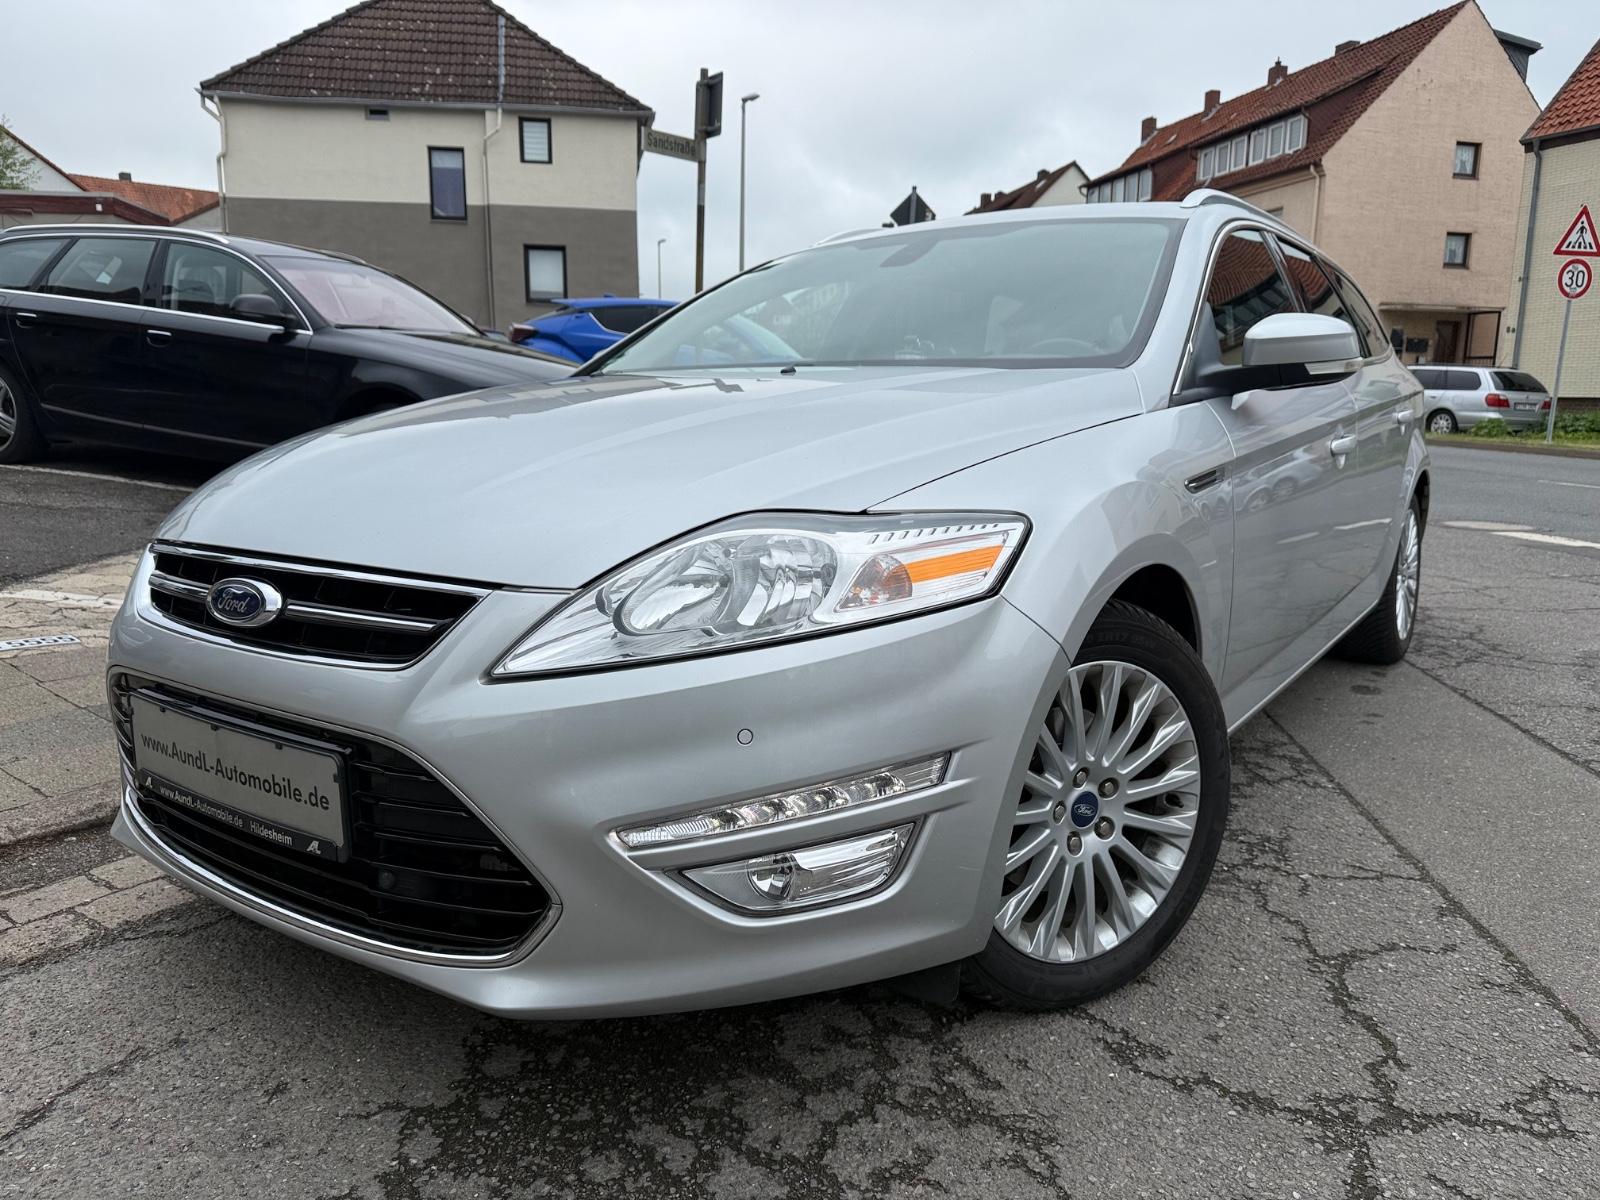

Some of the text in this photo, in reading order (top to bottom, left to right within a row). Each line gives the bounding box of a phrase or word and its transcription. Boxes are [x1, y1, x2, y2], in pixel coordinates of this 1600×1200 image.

[1564, 269, 1586, 288] 30
[217, 587, 251, 613] Ford
[141, 733, 330, 811] www.AundL-Automobile.de
[160, 786, 293, 847] www.AundL-Automobile.de Hildesheim
